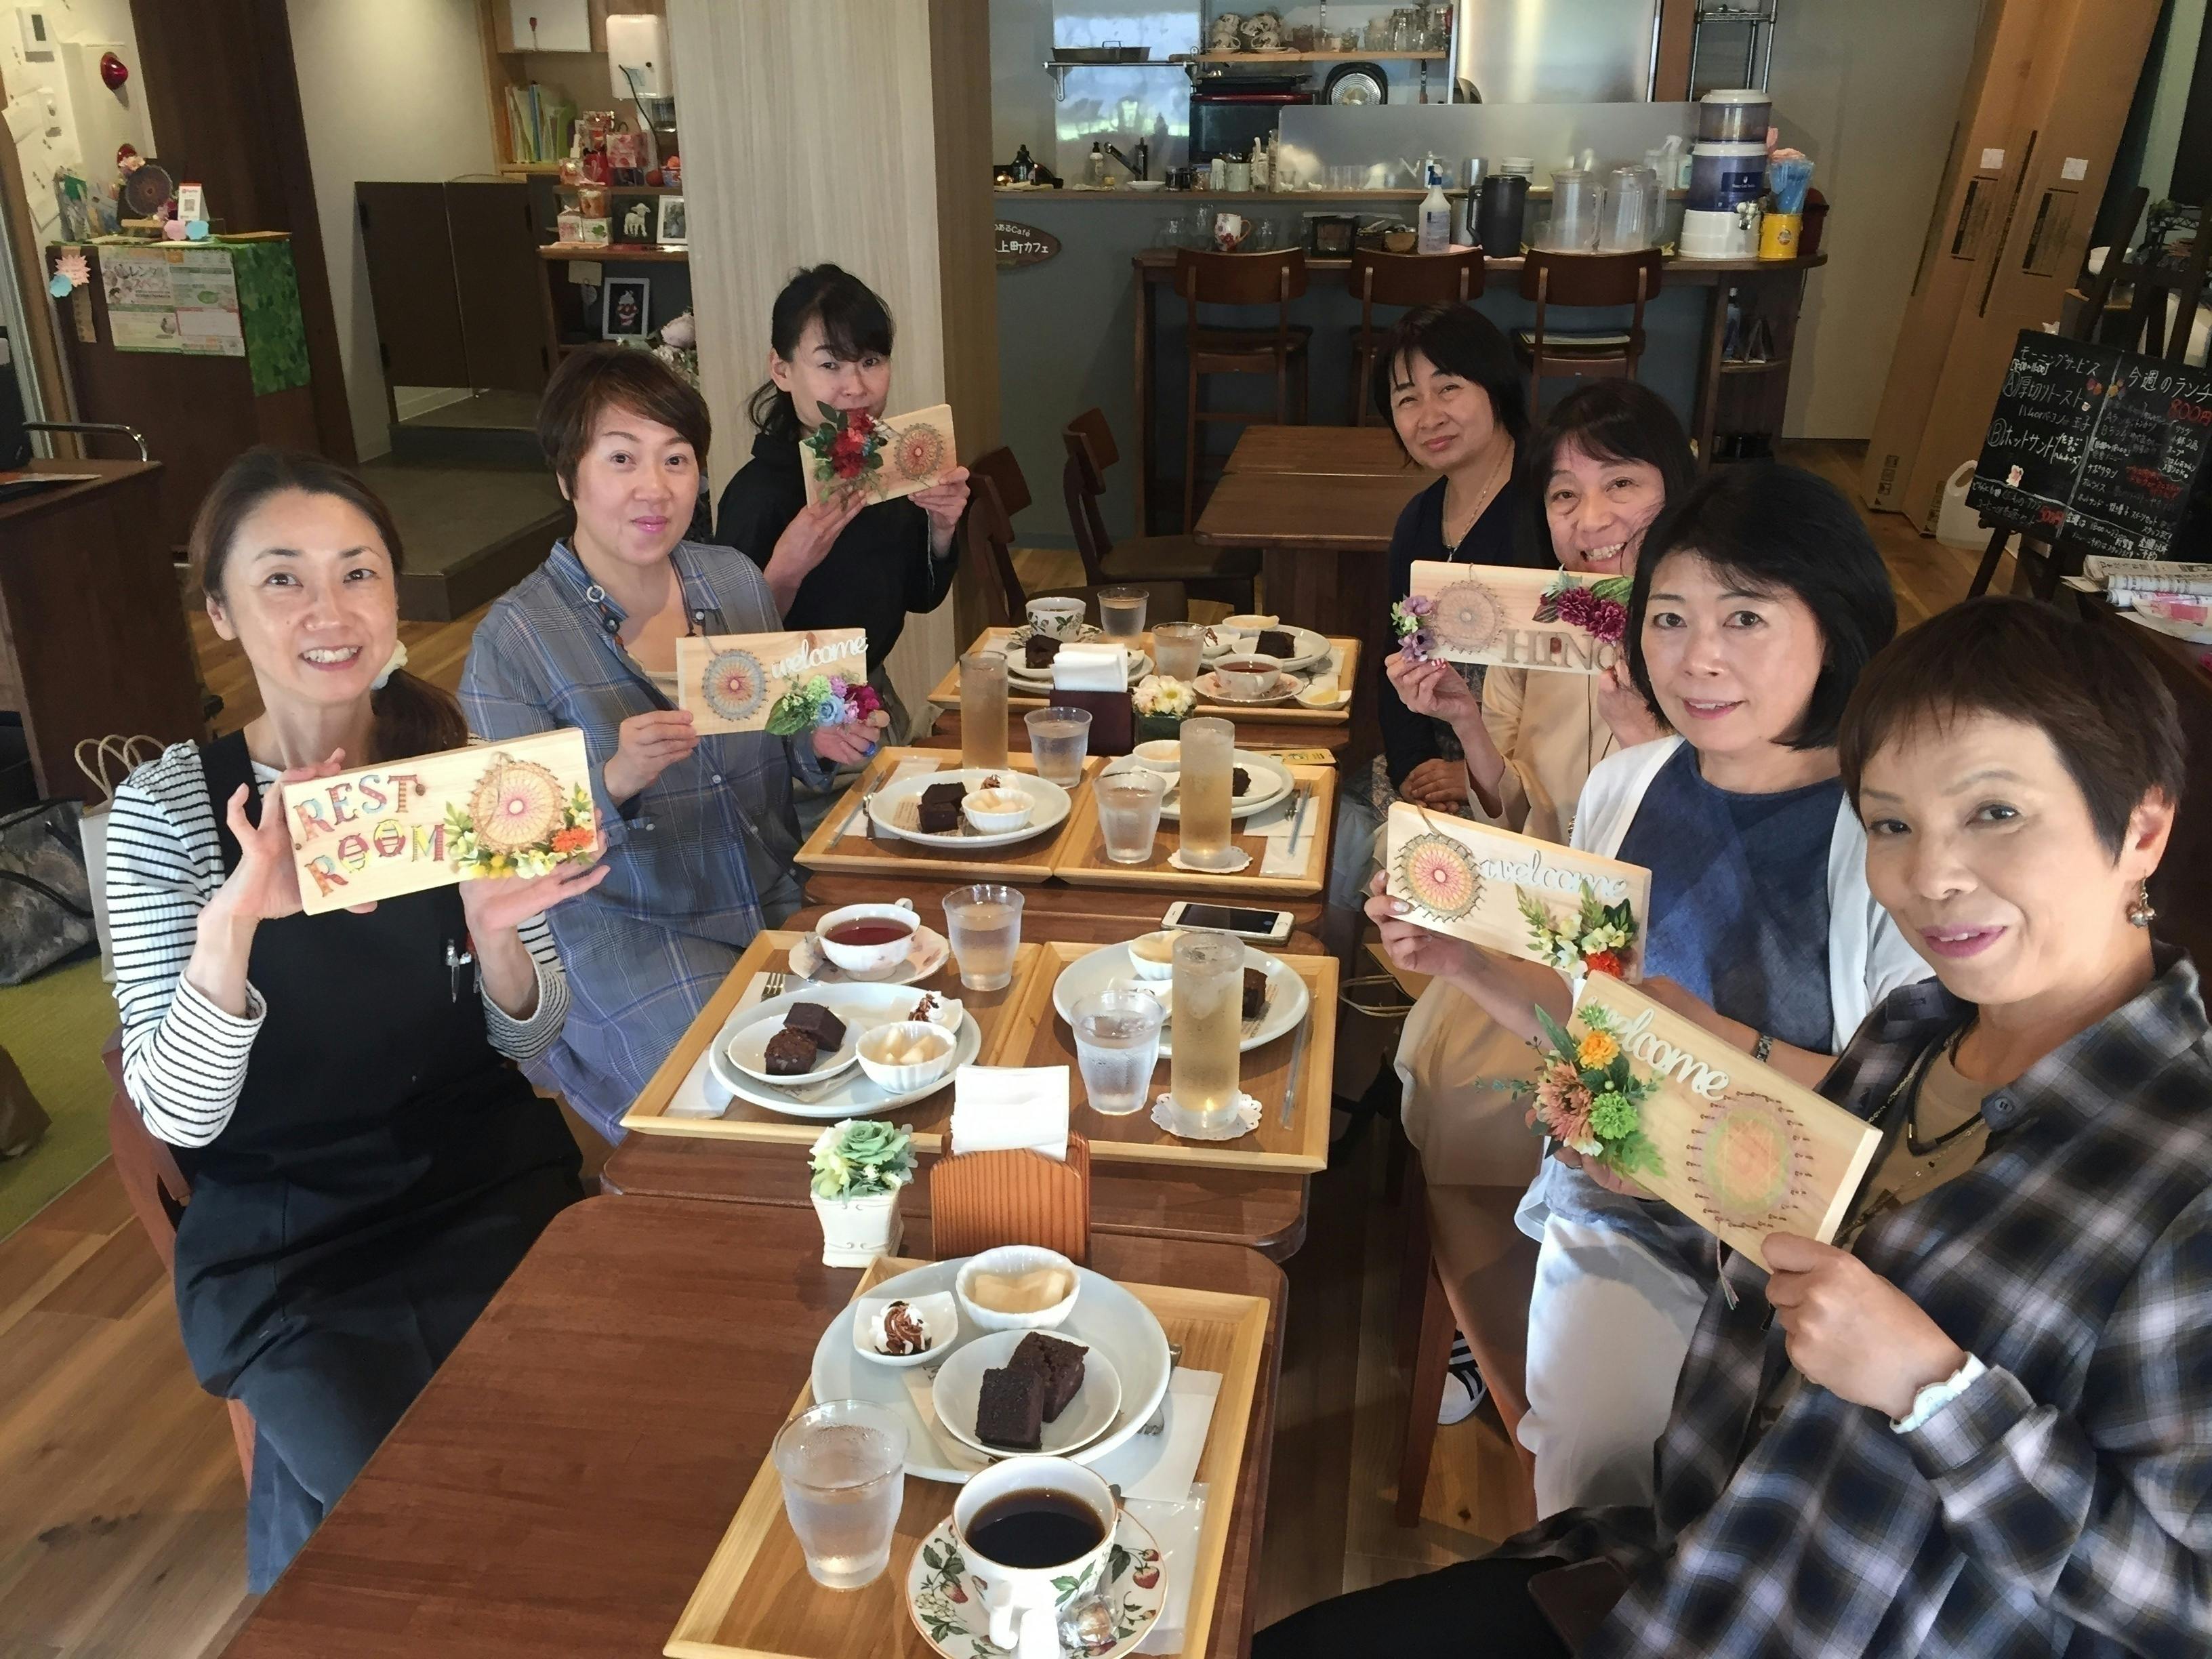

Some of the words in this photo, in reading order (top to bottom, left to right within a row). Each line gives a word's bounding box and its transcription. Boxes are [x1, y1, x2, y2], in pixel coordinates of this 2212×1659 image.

[995, 240, 1049, 254] 上町カフェ
[2128, 365, 2212, 403] 今週のランチ
[771, 635, 869, 678] welcome
[1501, 627, 1618, 670] HINO
[293, 774, 418, 842] REST
[304, 819, 446, 897] ROOM
[1479, 849, 1628, 897] welcome
